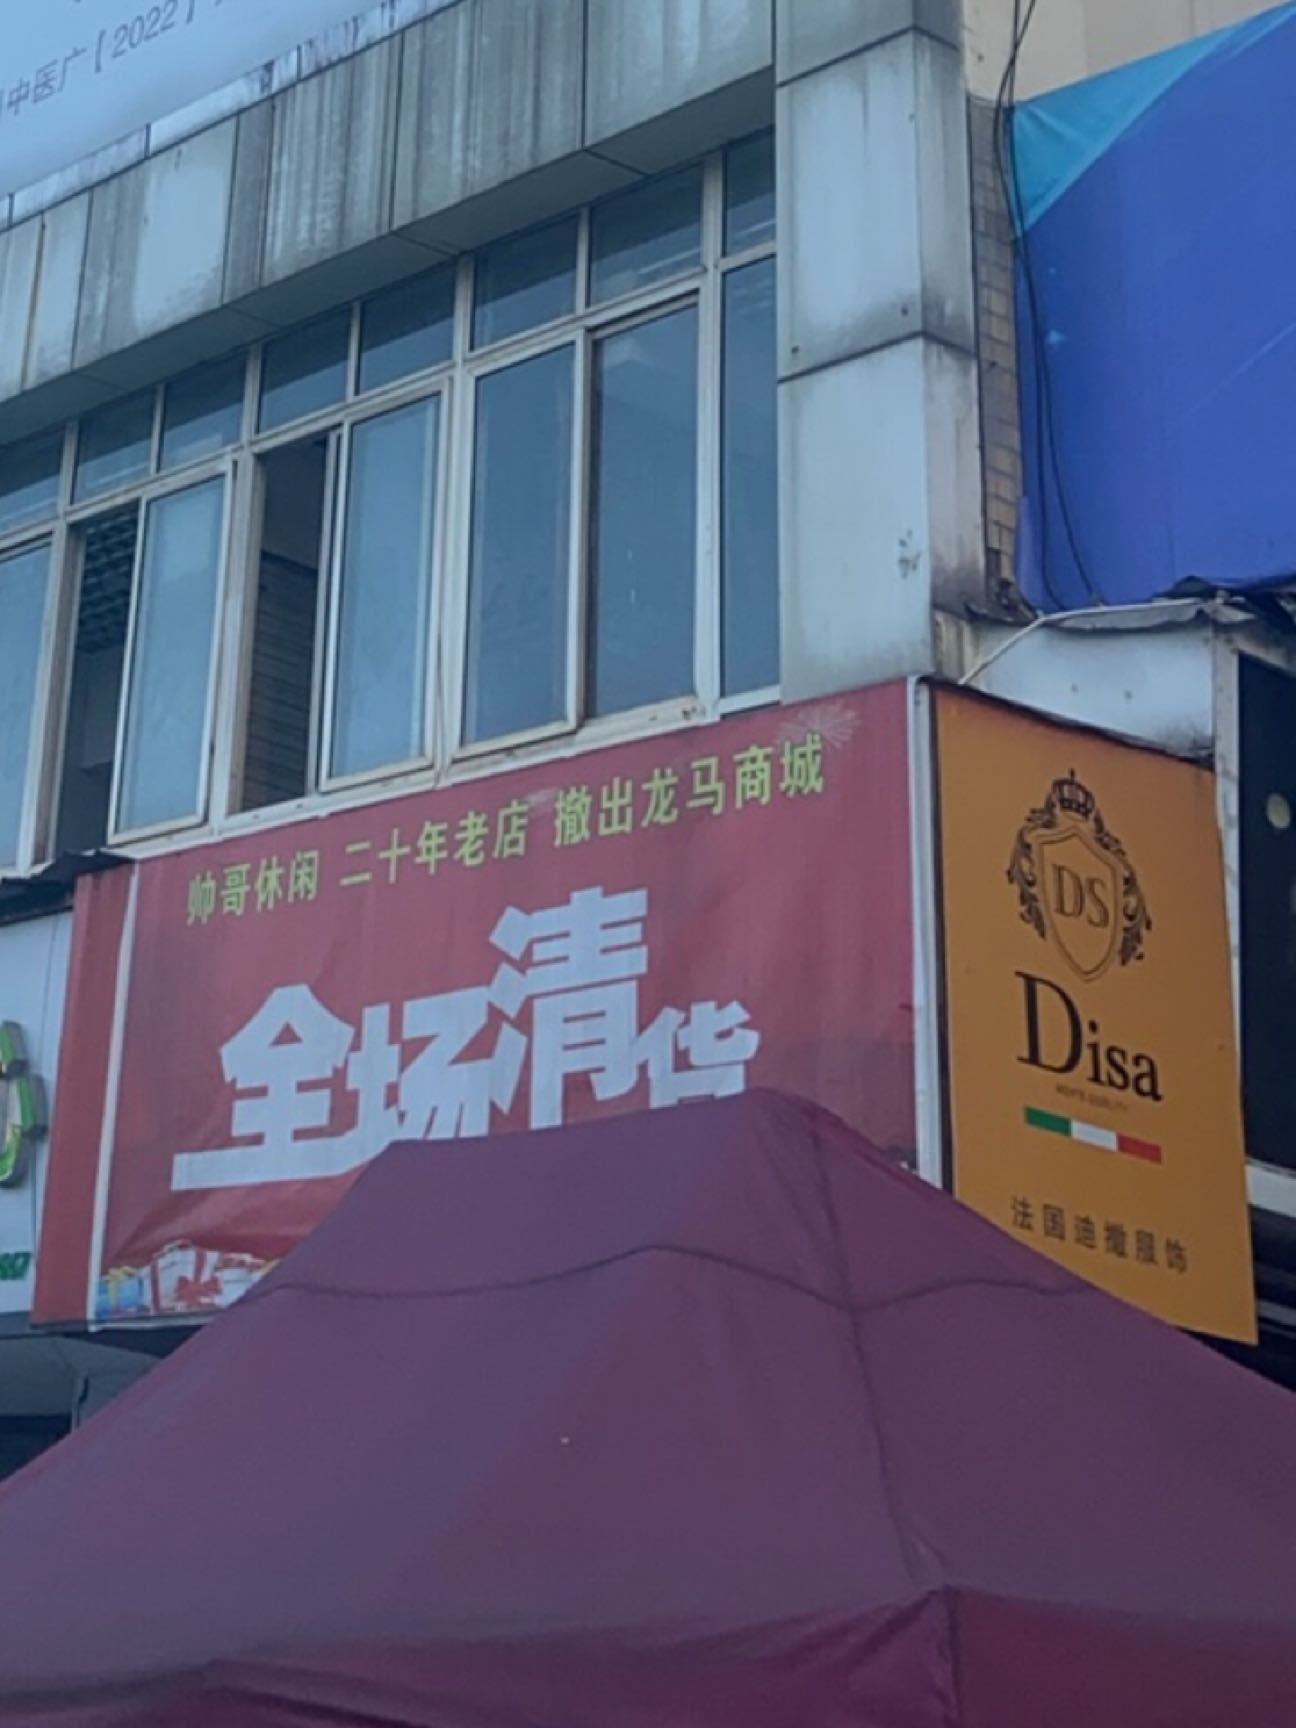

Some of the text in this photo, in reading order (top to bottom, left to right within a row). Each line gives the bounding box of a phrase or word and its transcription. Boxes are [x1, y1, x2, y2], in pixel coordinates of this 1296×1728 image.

[187, 732, 825, 925] 帅哥休闲 二十年老店 撤出龙马商城
[1051, 863, 1110, 928] DS
[1014, 970, 1164, 1102] Disa
